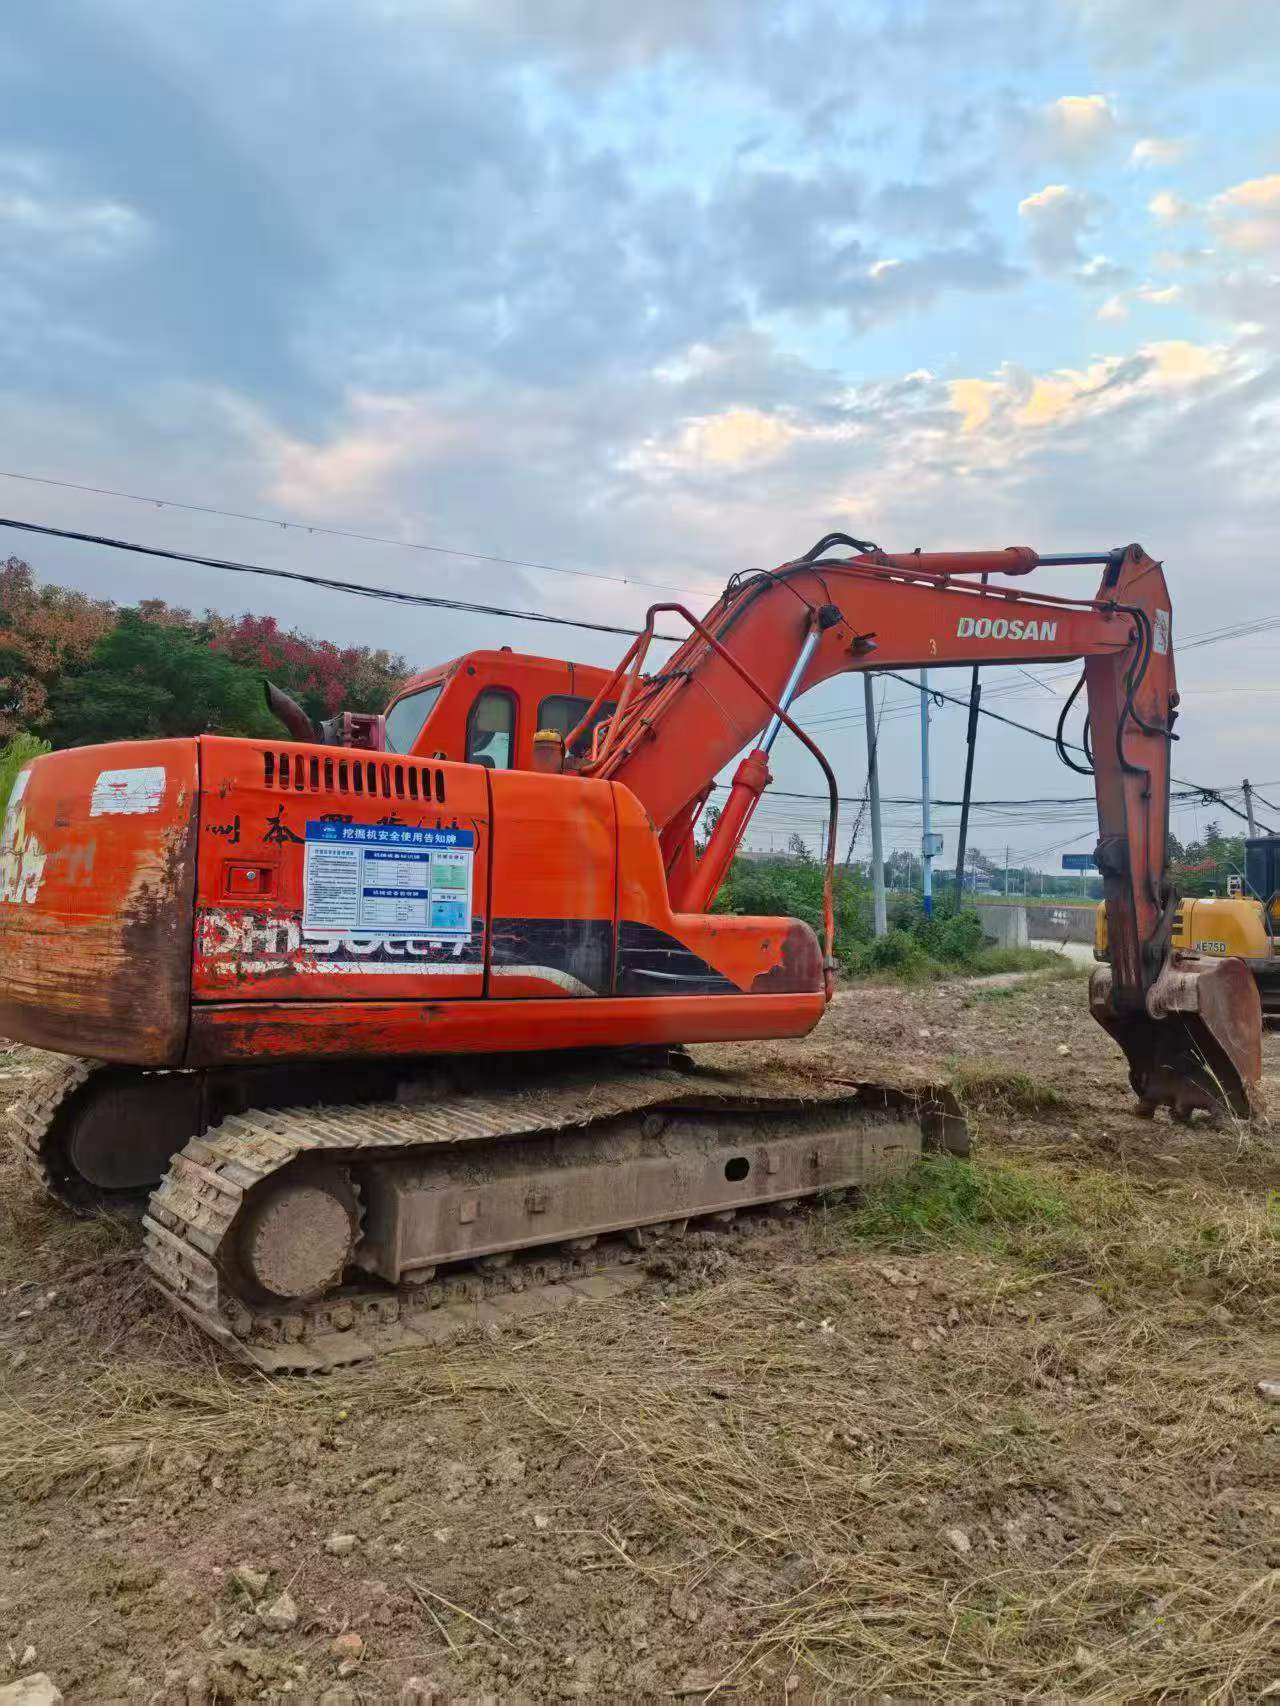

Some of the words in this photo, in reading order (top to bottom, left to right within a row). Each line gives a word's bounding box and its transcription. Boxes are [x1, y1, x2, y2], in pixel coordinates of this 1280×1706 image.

[957, 617, 1058, 641] DOOSAN
[342, 828, 457, 844] 挖掘机安全使用告知牌
